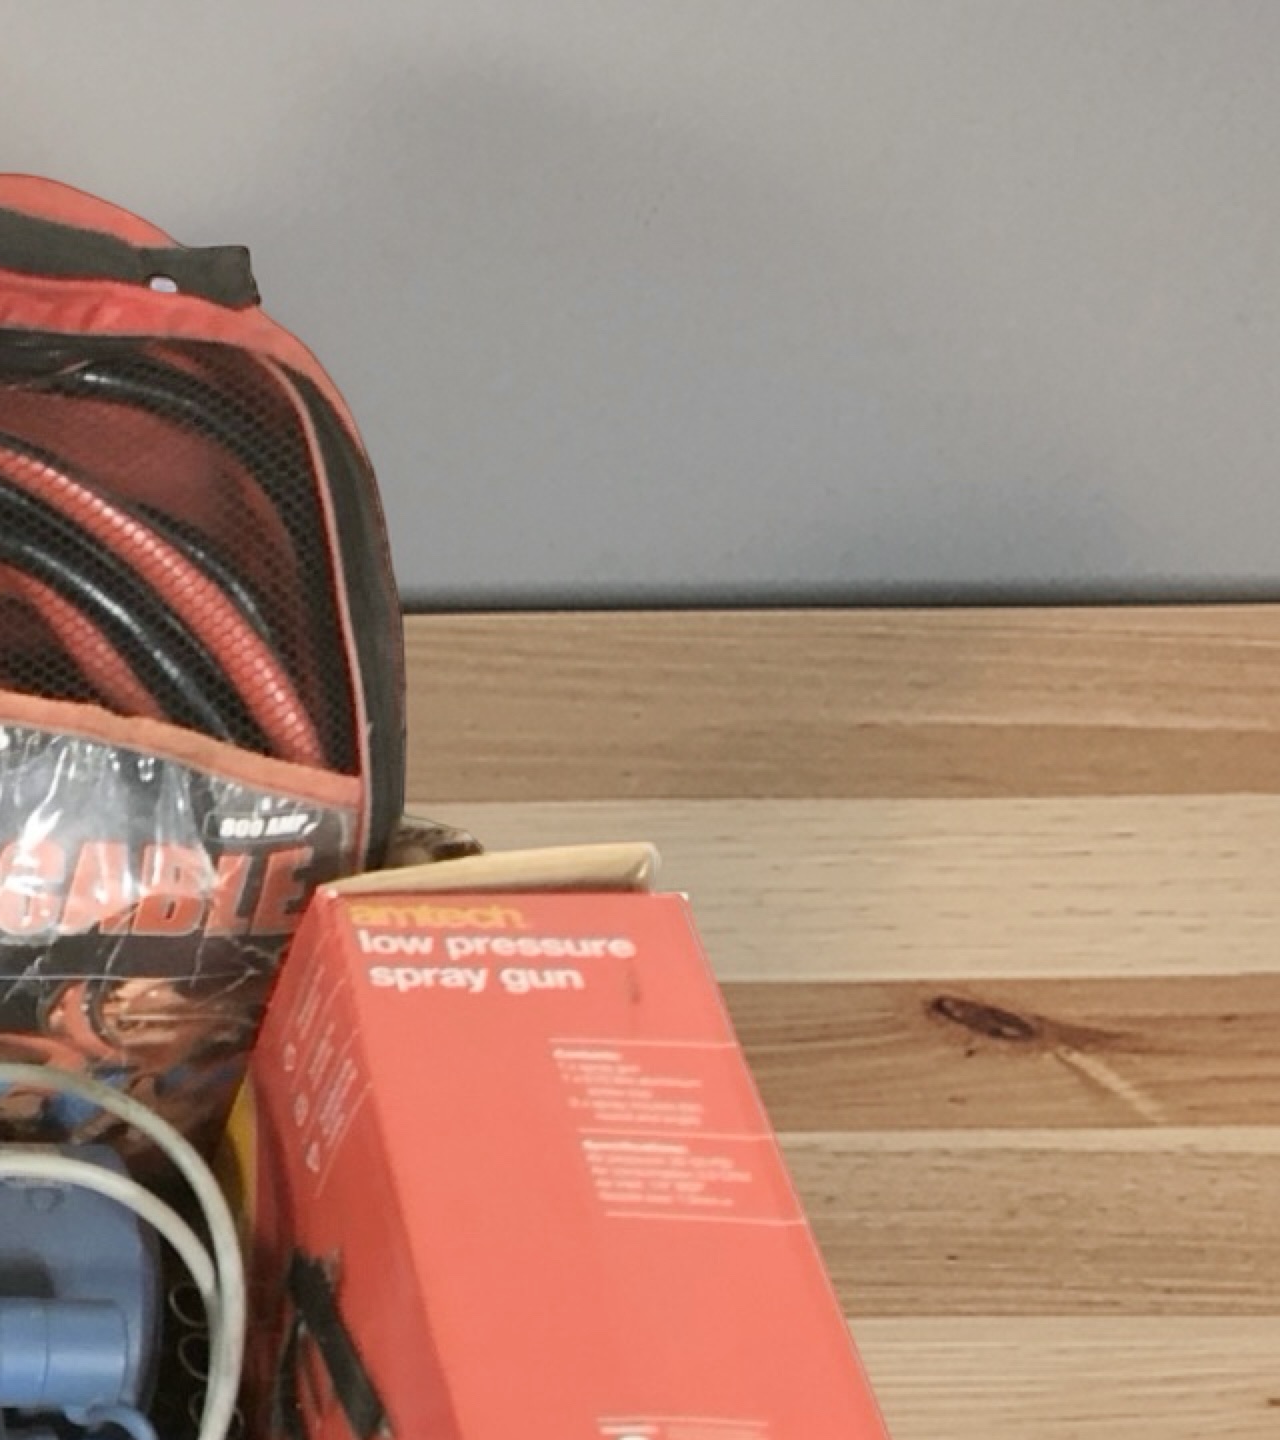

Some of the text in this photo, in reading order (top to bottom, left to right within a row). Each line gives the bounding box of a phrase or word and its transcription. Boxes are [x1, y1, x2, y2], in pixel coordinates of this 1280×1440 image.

[349, 903, 523, 928] amtech
[357, 928, 637, 960] low pressure
[369, 964, 585, 994] spray gun
